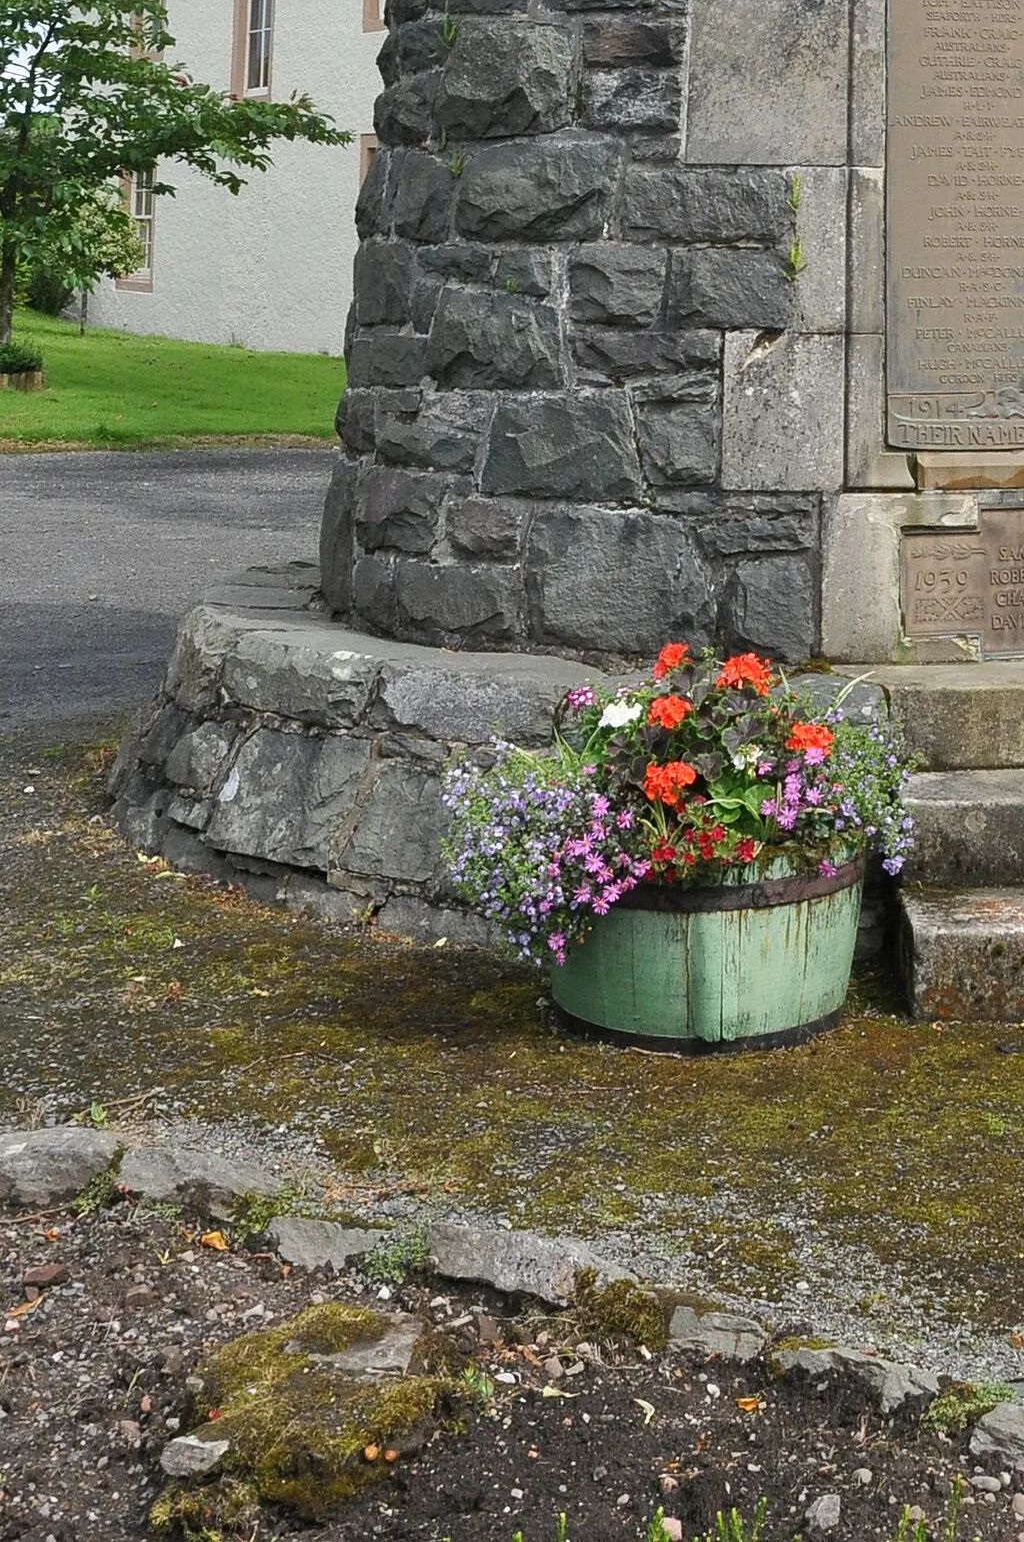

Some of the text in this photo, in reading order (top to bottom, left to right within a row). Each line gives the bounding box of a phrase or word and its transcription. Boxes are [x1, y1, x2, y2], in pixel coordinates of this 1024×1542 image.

[924, 27, 971, 39] FRANK
[919, 55, 975, 67] GUTHRIE
[920, 84, 963, 99] JAMES
[889, 114, 951, 127] ANDREW
[910, 145, 953, 160] JAMES
[928, 174, 968, 187] DAVID
[928, 205, 964, 220] JOHN
[923, 236, 972, 248] ROBERT
[901, 266, 962, 279] DUNCAN
[907, 296, 957, 309] FINLAY
[915, 328, 954, 340] PETER
[917, 358, 956, 370] HUGH
[939, 373, 984, 385] GORDON
[897, 423, 964, 446] THEIR
